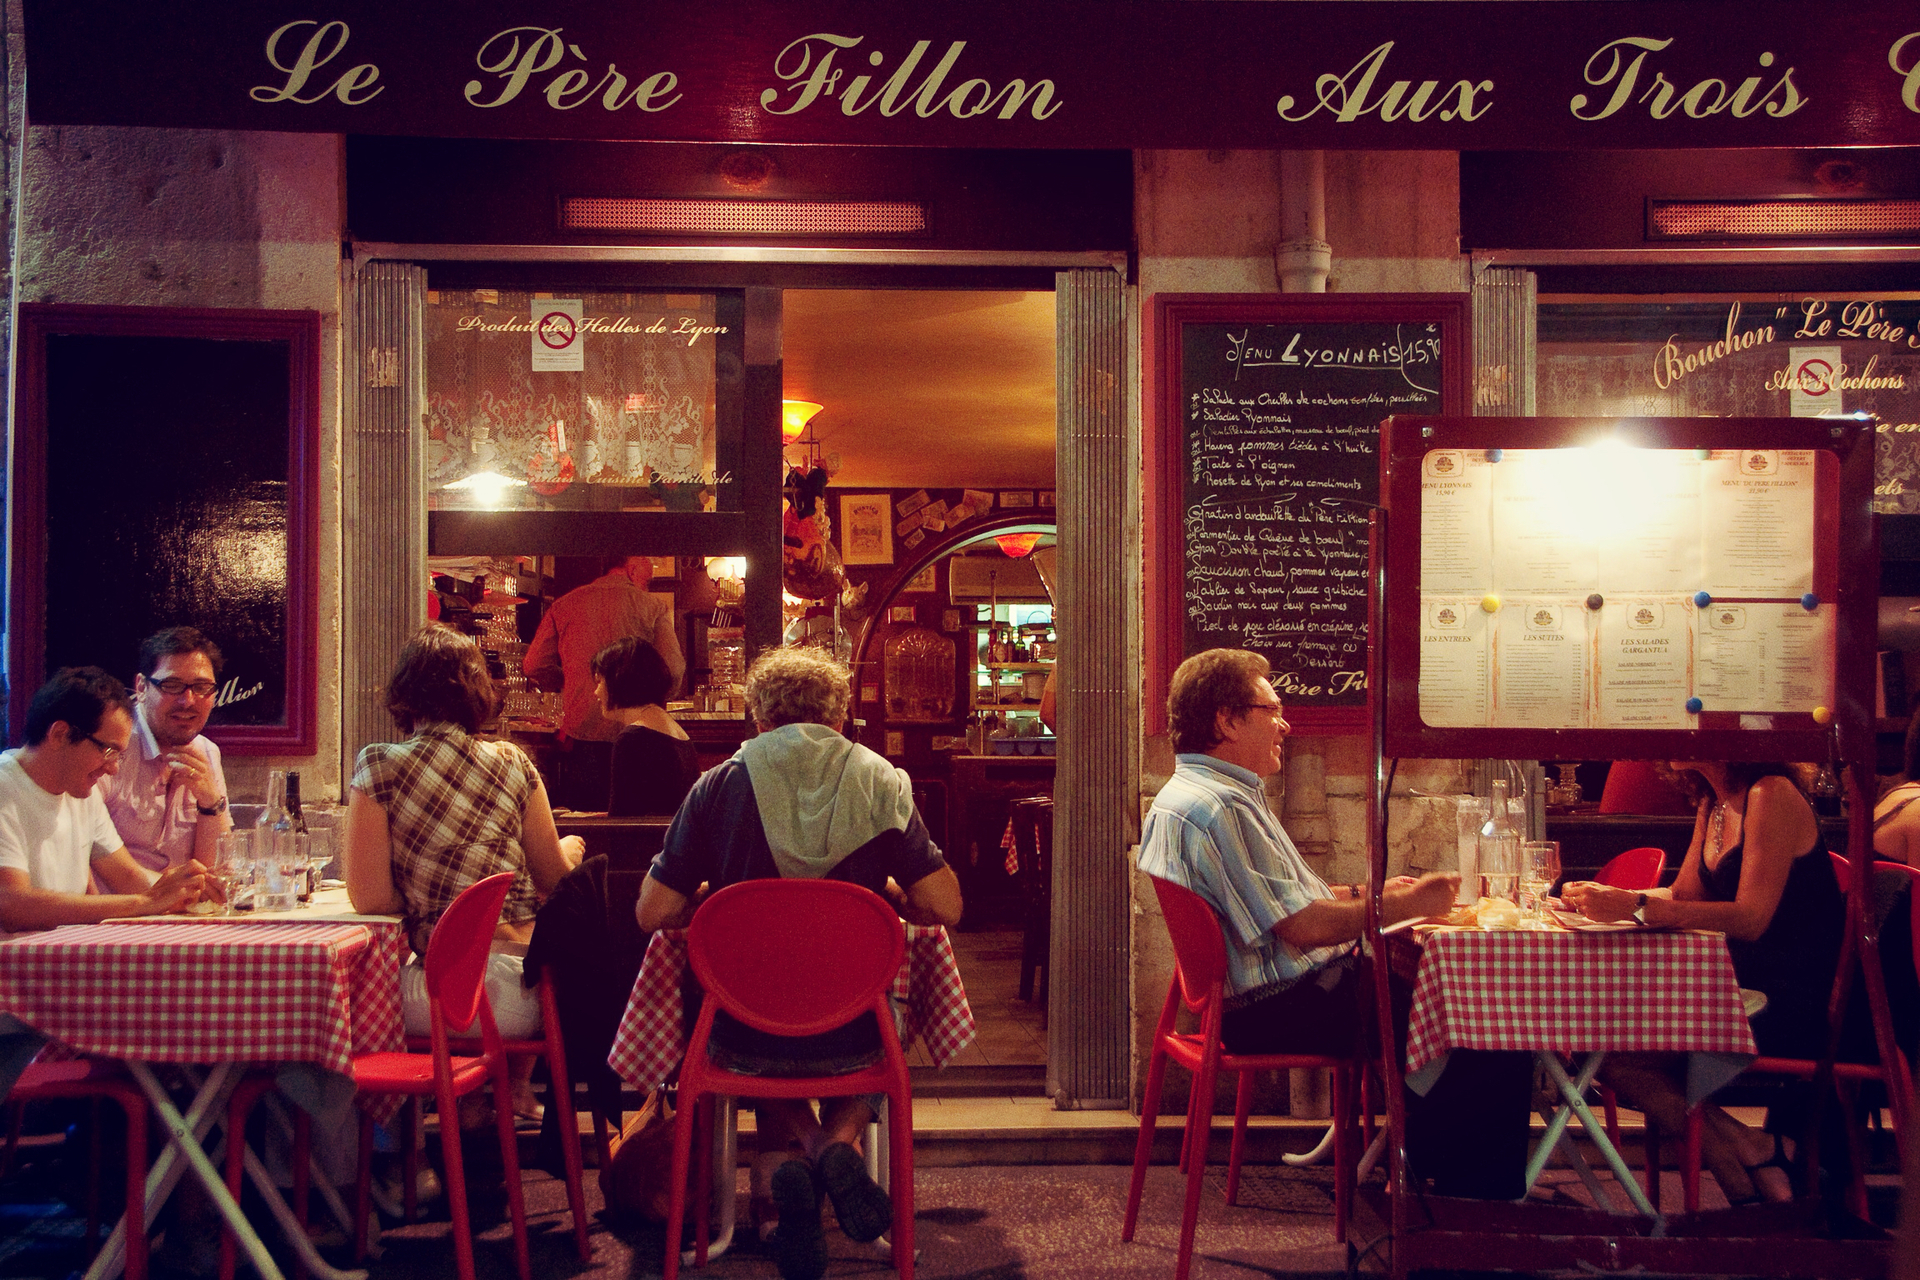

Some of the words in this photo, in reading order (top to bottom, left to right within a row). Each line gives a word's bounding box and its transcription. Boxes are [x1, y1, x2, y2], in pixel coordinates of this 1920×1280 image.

[249, 19, 385, 107] Le
[464, 25, 684, 114] Père
[760, 33, 1063, 120] Fillon
[1277, 40, 1494, 123] Aux
[1569, 36, 1810, 121] Trois
[456, 315, 539, 333] Produit
[541, 315, 570, 333] des
[575, 317, 642, 334] Halles
[645, 317, 667, 334] de
[672, 317, 729, 346] Lyon
[1654, 300, 1775, 389] Bouchon
[1837, 300, 1904, 342] Père
[1829, 354, 1904, 391] Cochons
[1203, 388, 1235, 404] Salade
[1296, 390, 1309, 404] de
[1203, 408, 1240, 421] Saladier
[1202, 456, 1231, 469] Tarte
[1236, 459, 1245, 468] à
[1240, 475, 1252, 485] de
[1279, 477, 1290, 486] et
[1188, 505, 1233, 520] Gratin
[1298, 507, 1311, 522] du
[1244, 526, 1256, 541] de
[1299, 528, 1311, 544] de
[1293, 548, 1301, 557] à
[1192, 554, 1250, 576] Saucisson
[1290, 567, 1325, 583] pommes
[1234, 582, 1245, 595] de
[1324, 583, 1367, 601] gribiche
[1193, 596, 1232, 612] Boudin
[1261, 602, 1278, 611] aux
[1310, 602, 1347, 615] pommes
[1191, 612, 1223, 631] Pied
[1228, 617, 1239, 631] de
[1269, 671, 1321, 696] Père
